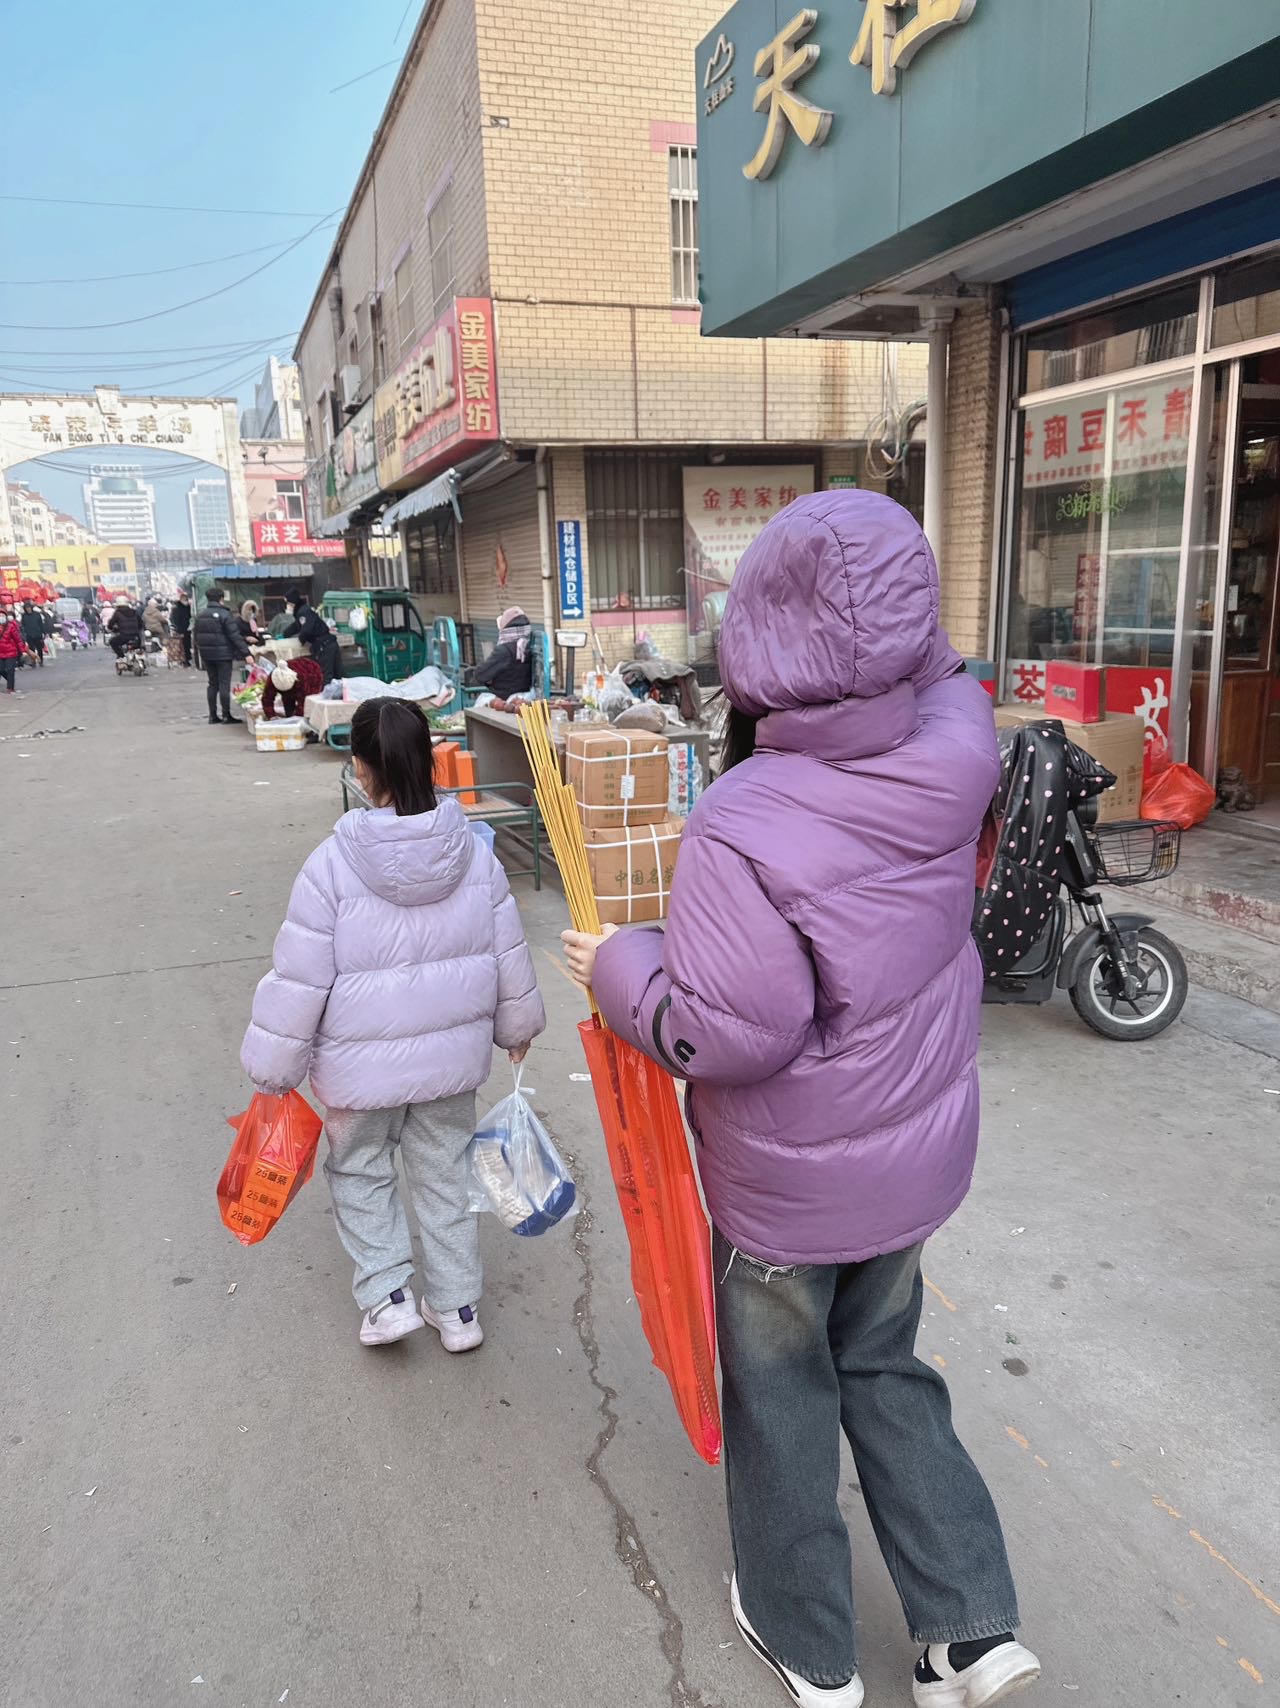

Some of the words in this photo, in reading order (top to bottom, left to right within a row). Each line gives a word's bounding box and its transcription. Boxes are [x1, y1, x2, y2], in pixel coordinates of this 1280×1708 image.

[460, 311, 492, 432] 金美家纺
[100, 433, 124, 443] TIG
[1013, 664, 1045, 703] 茶
